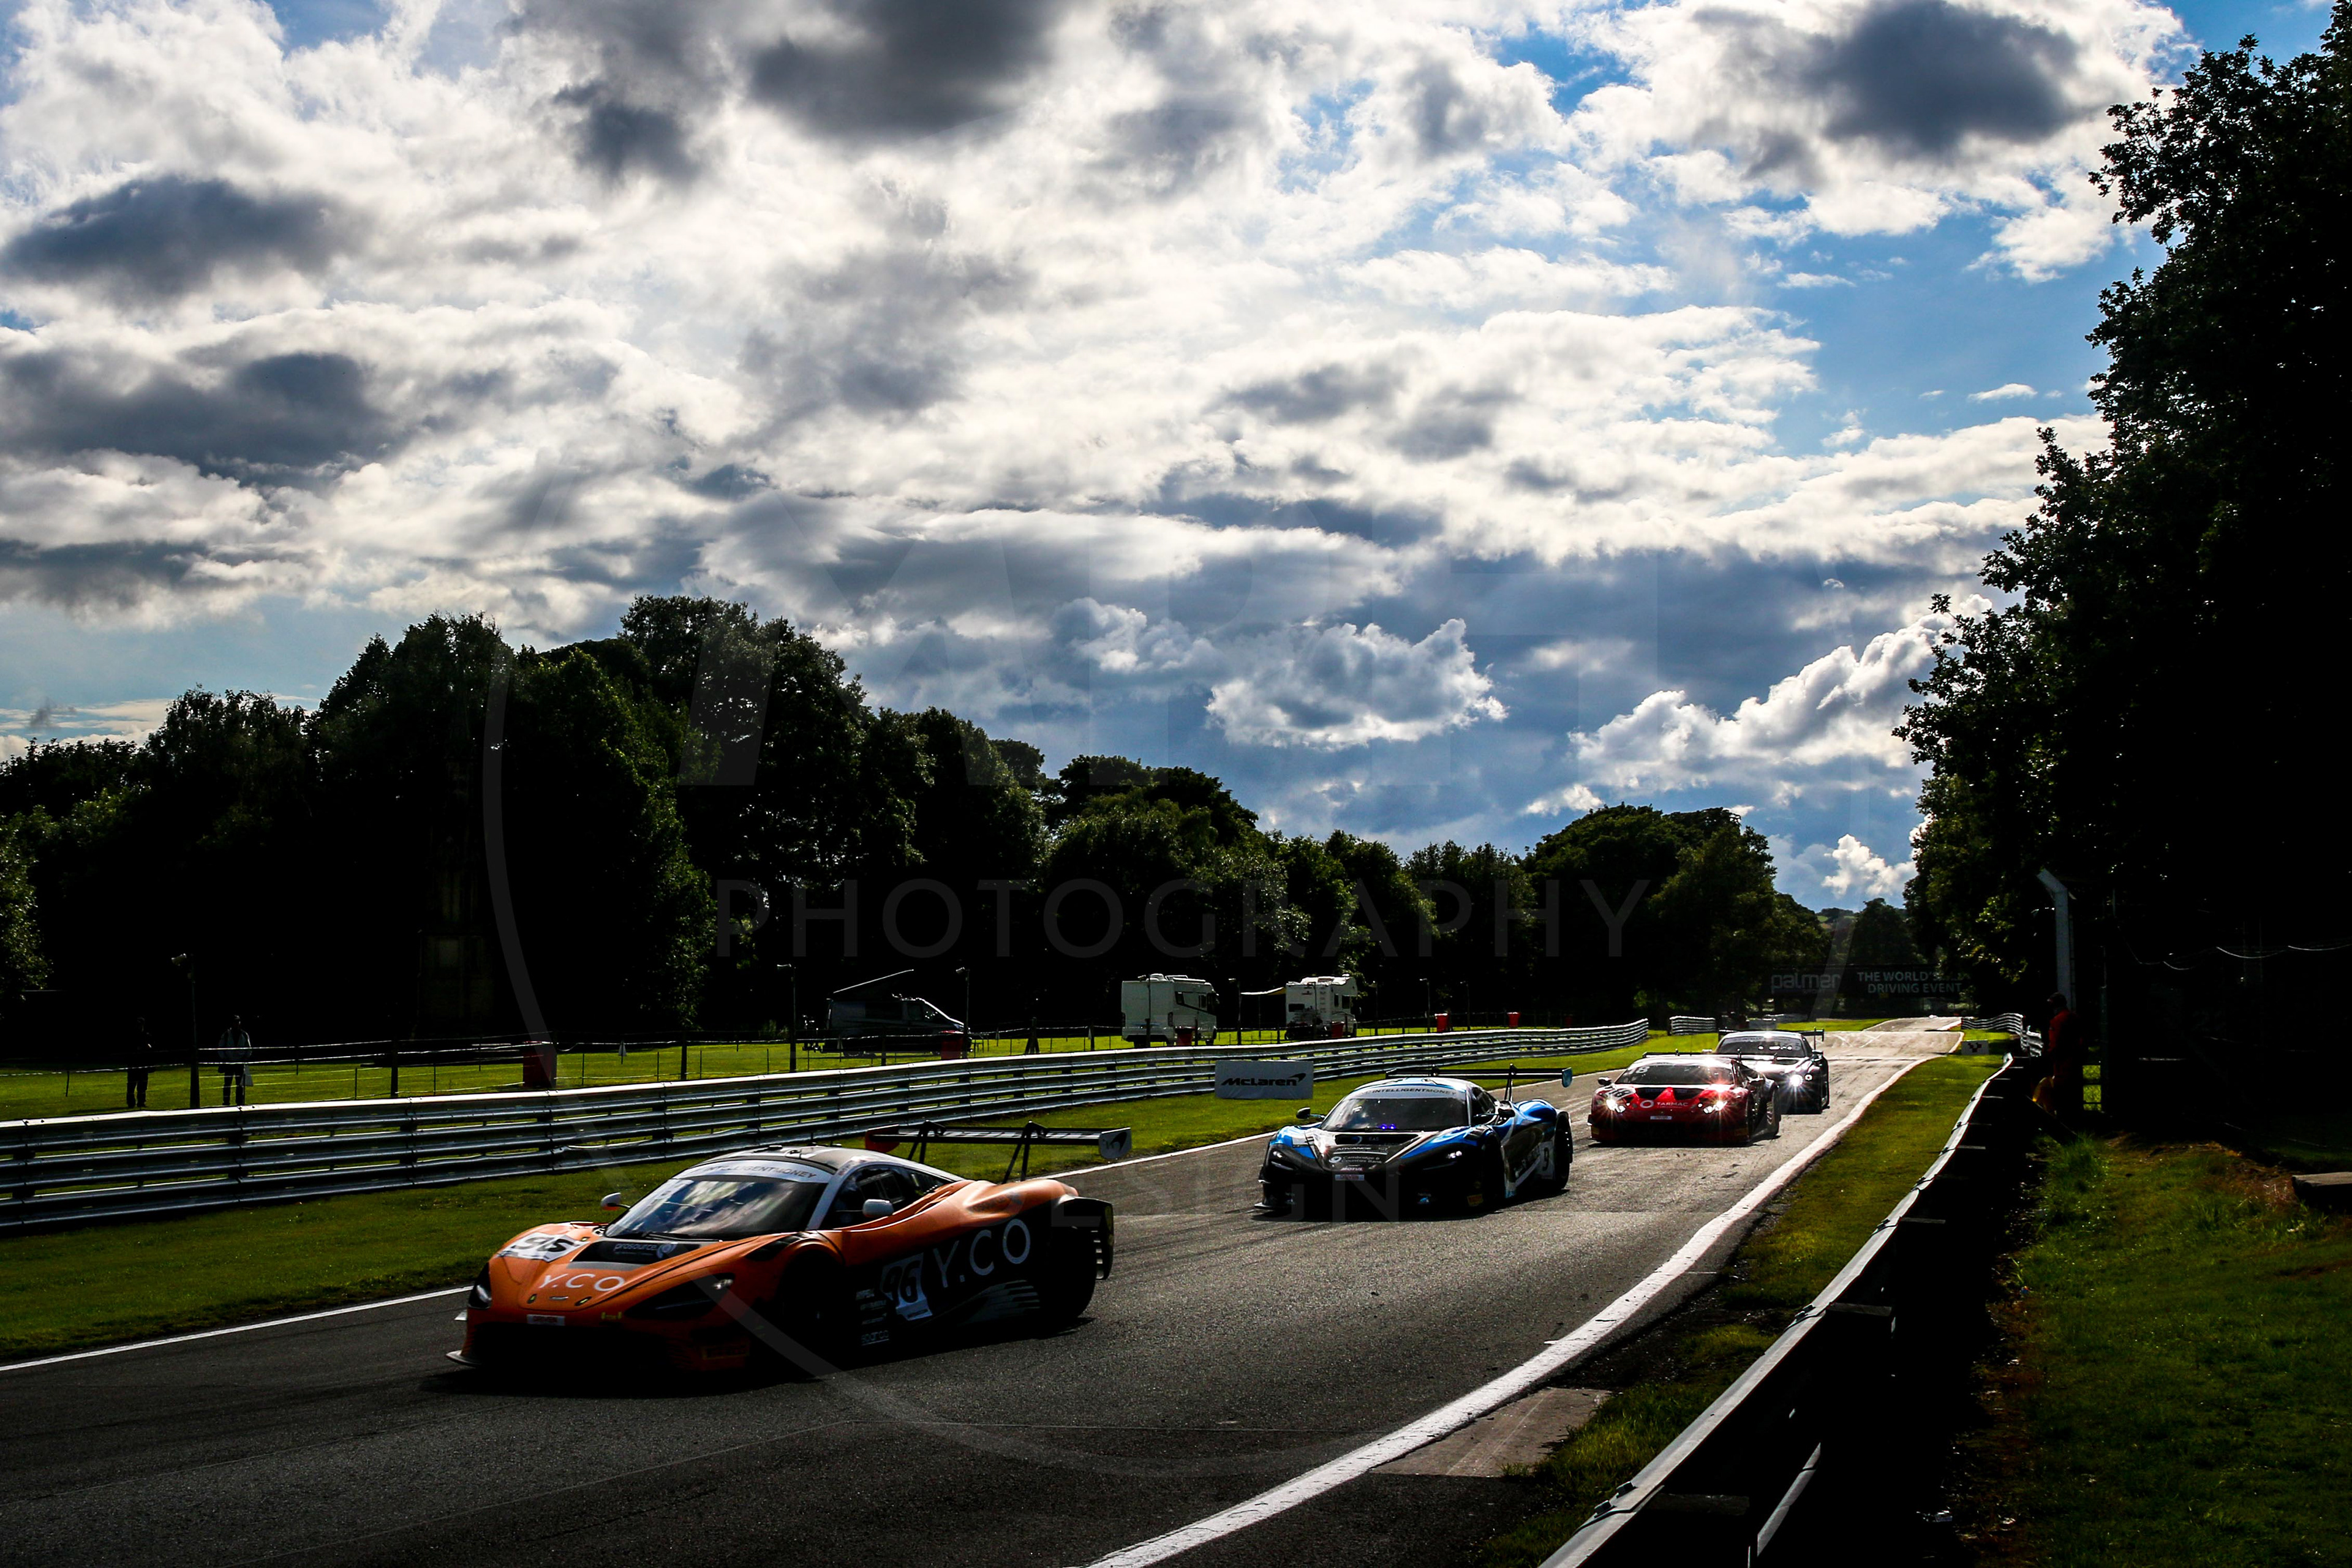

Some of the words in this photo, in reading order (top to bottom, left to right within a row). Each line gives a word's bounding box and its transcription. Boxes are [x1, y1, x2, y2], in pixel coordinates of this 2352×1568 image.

[1857, 972, 1880, 981] THE
[1868, 984, 1920, 993] DRIVING
[1923, 983, 1962, 993] EVENT
[1221, 1077, 1297, 1086] McLaren
[932, 1218, 1031, 1288] Y.CO
[539, 1273, 626, 1292] Y.CO
